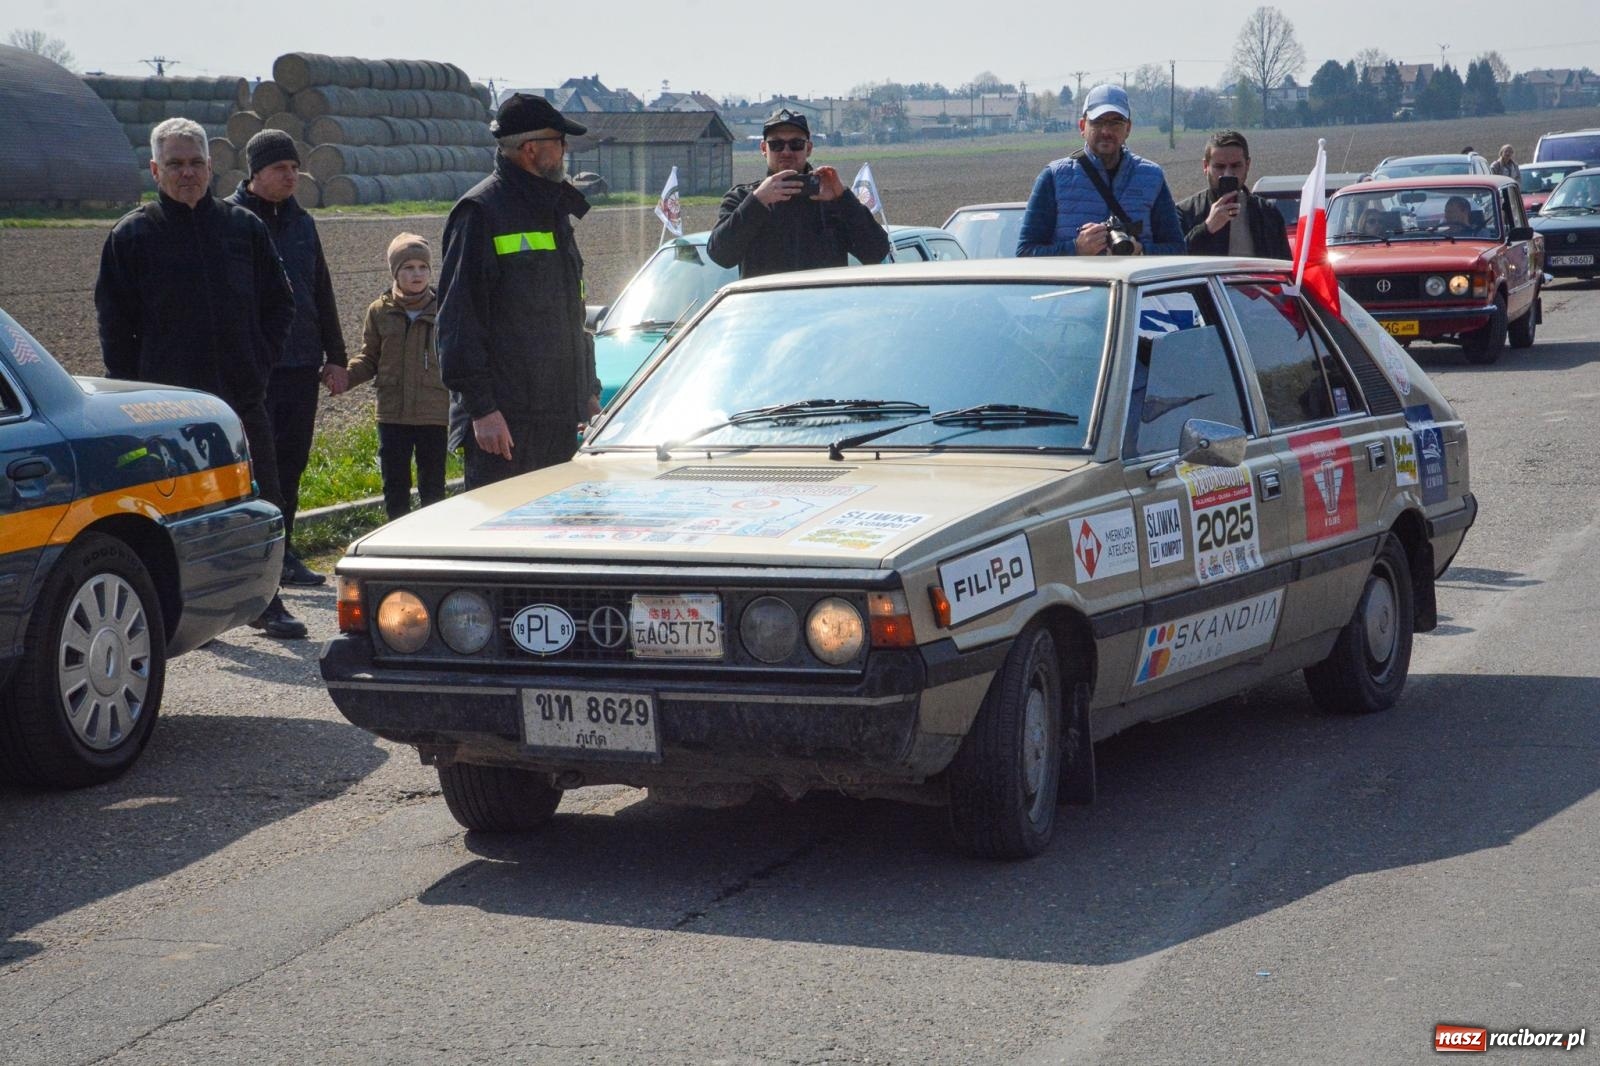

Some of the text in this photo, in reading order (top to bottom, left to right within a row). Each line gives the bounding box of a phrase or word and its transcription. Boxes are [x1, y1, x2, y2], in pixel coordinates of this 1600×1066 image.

[1105, 526, 1133, 542] MERKURY
[1146, 507, 1180, 538] ŚLIWKA
[1197, 502, 1254, 553] 2025
[1107, 541, 1136, 558] ATELIERS
[1161, 539, 1181, 558] KOMPOT
[953, 556, 1024, 602] FILIPPO
[516, 614, 571, 644] 19 PL 81
[586, 696, 650, 726] 8629
